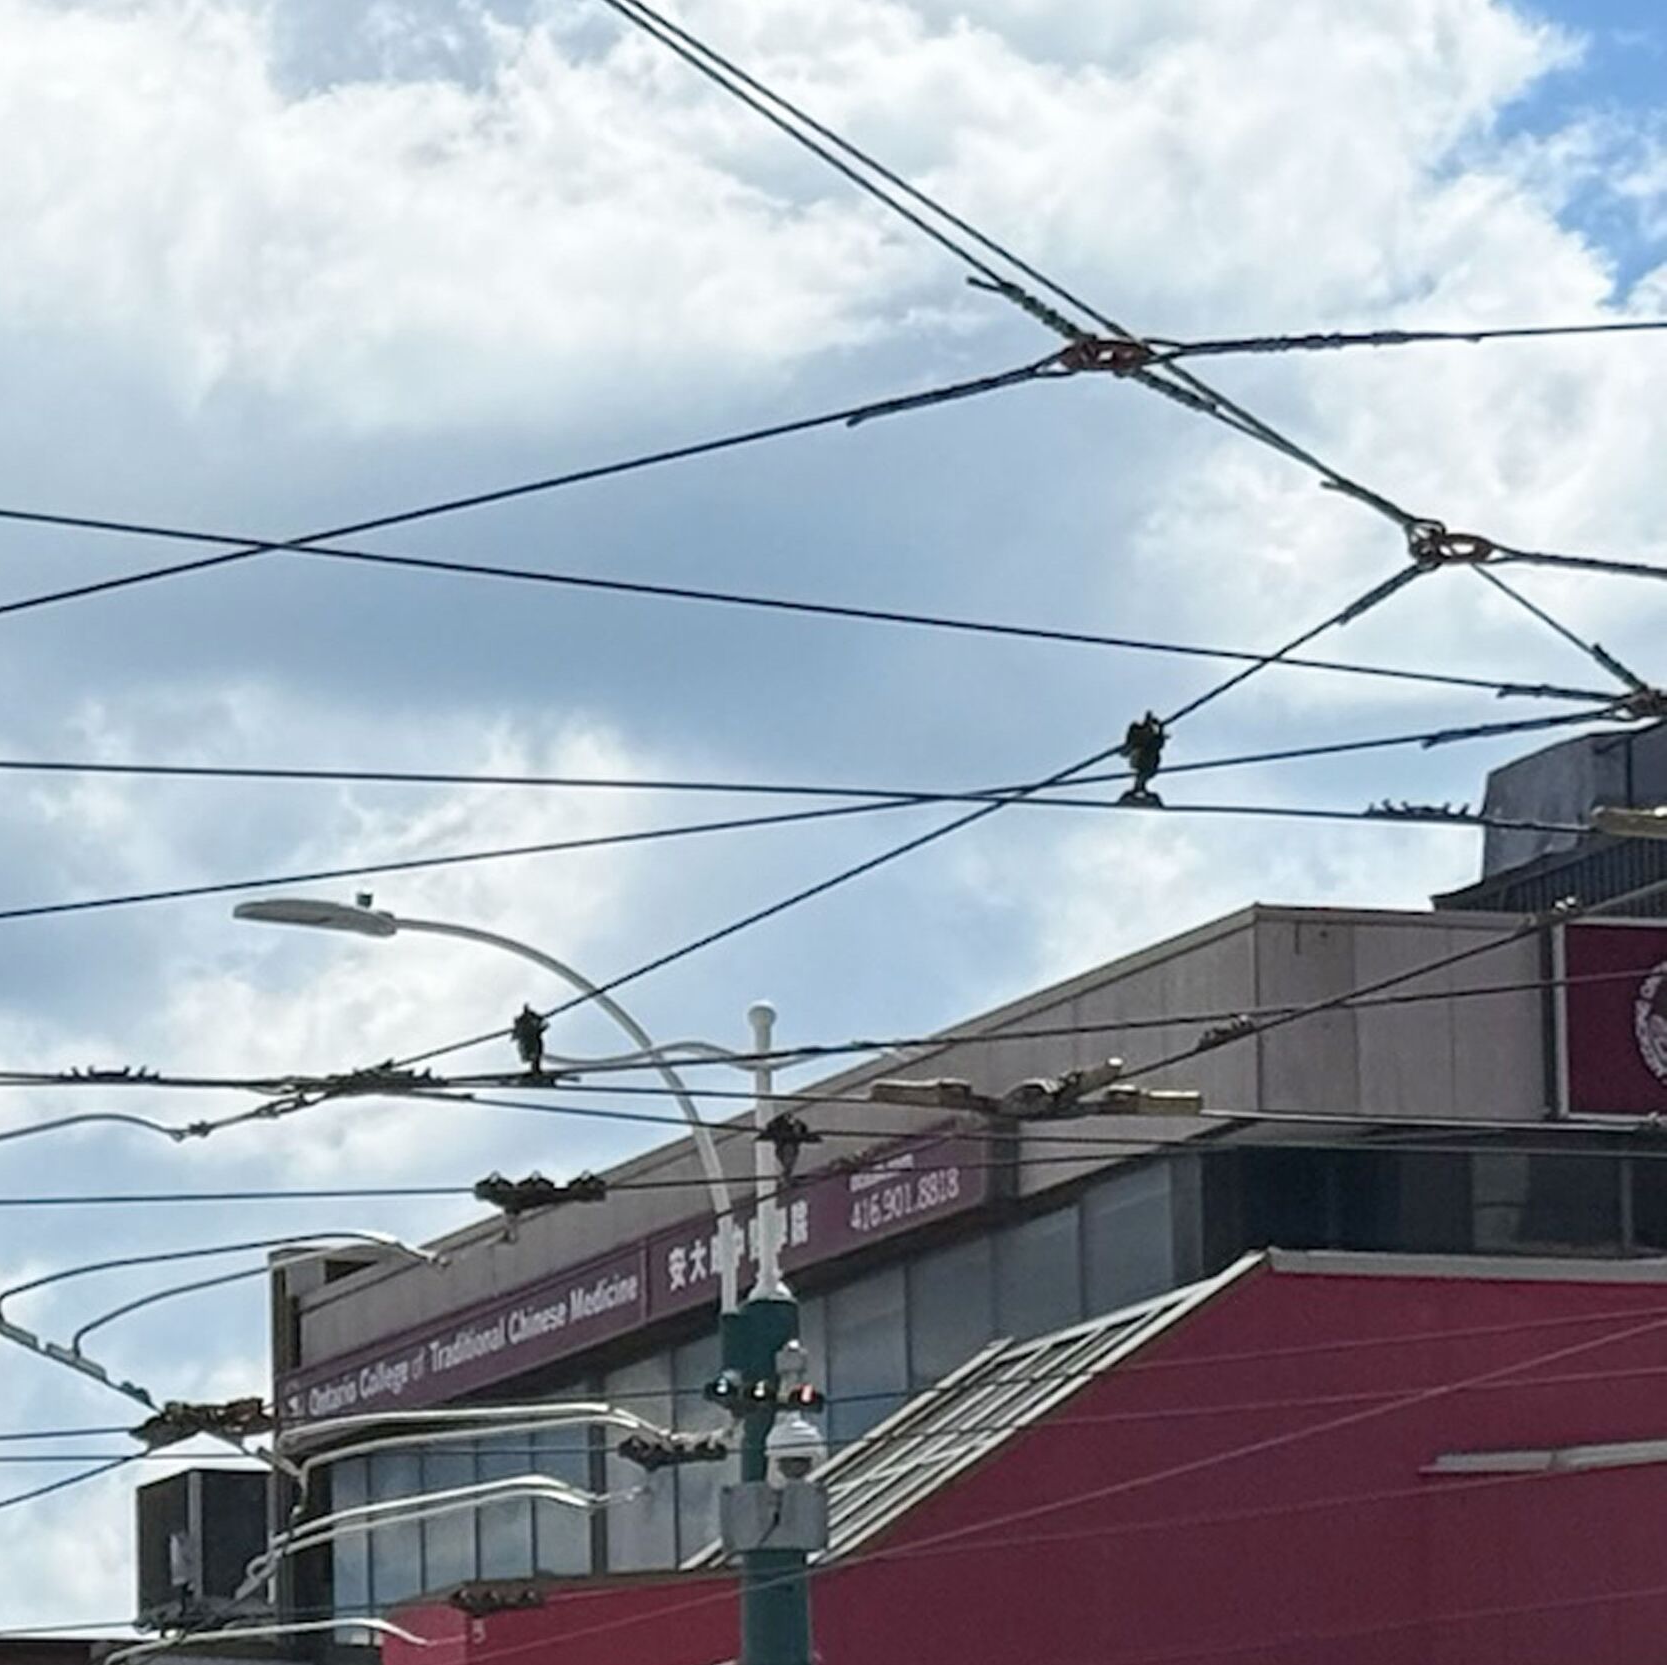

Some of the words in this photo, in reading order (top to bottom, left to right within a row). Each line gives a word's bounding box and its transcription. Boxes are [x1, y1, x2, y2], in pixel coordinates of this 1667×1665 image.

[308, 1378, 357, 1416] Ontario
[359, 1358, 409, 1397] College
[428, 1318, 506, 1372] Traditional
[508, 1302, 567, 1345] Chinese
[569, 1273, 639, 1322] Medicine
